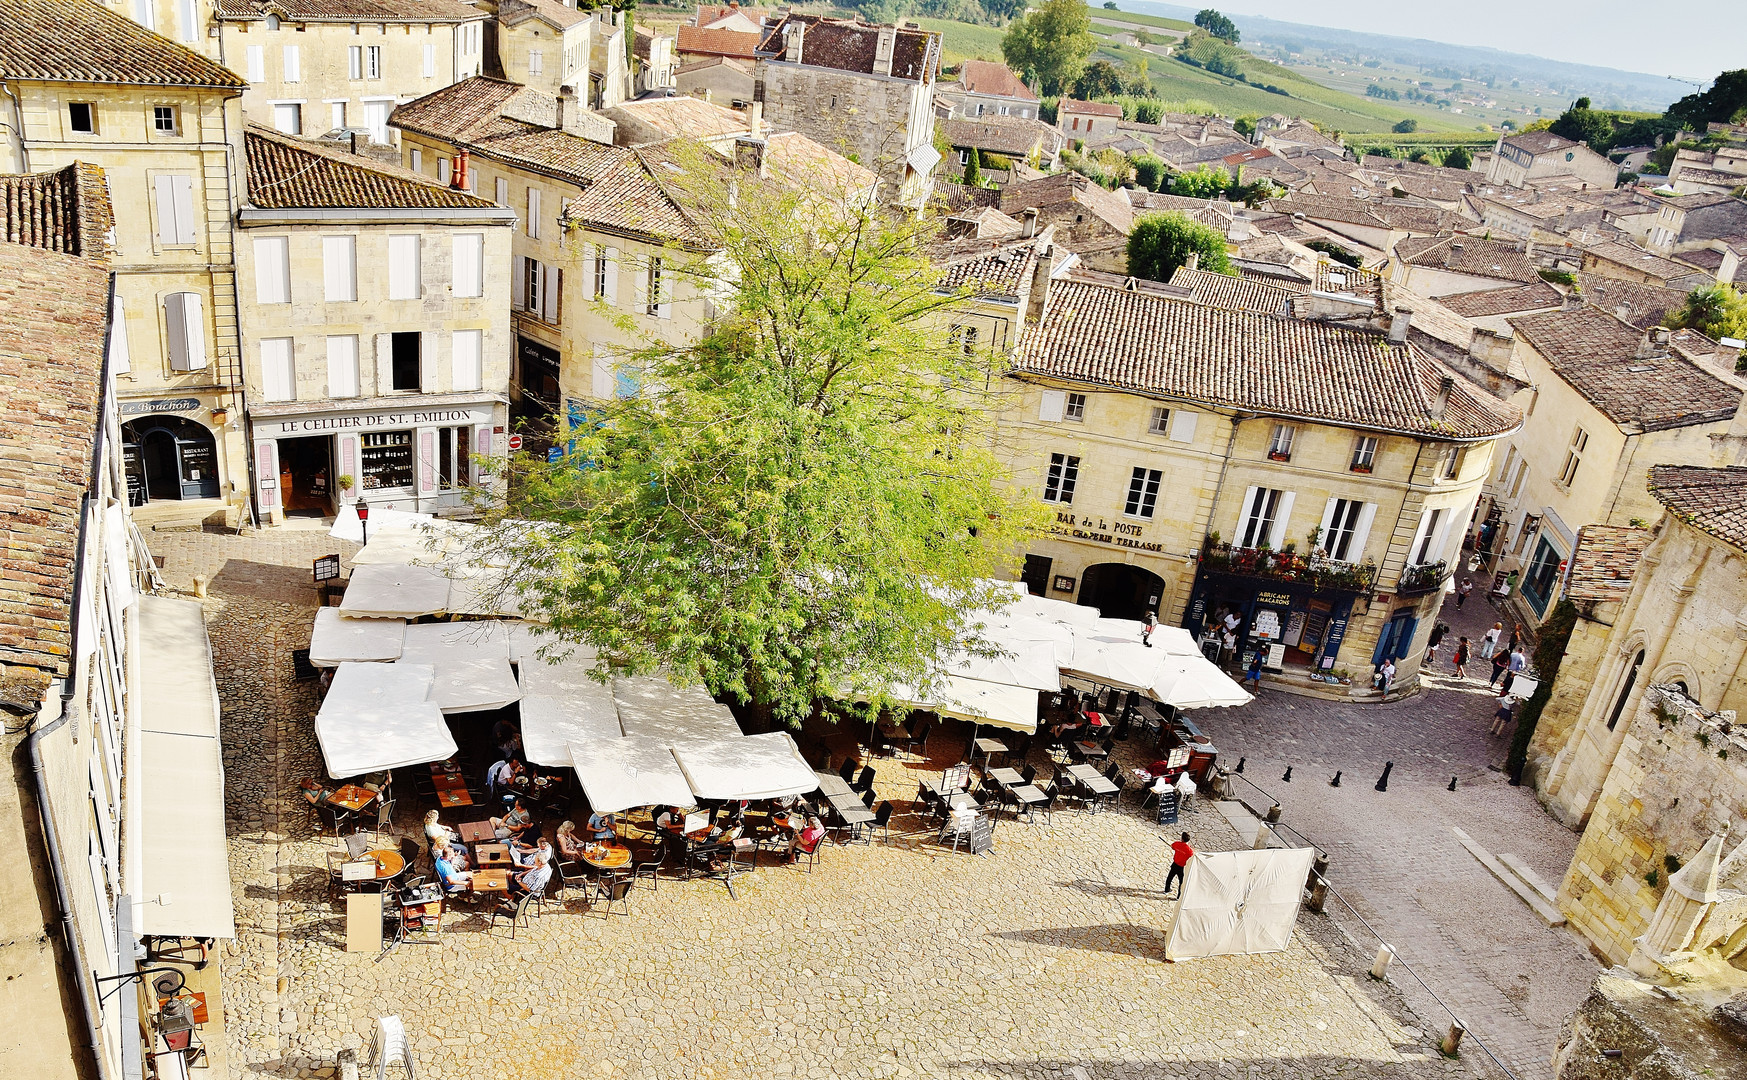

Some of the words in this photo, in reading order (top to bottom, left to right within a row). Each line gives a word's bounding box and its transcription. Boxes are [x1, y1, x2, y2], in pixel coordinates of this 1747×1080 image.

[121, 403, 135, 412] Le
[137, 400, 190, 412] Bouchon
[281, 421, 298, 432] LE
[303, 416, 361, 431] CELLIER
[366, 415, 384, 426] DE
[389, 414, 409, 424] ST.
[414, 410, 471, 423] EMILION
[1057, 512, 1076, 526] BAR
[1082, 517, 1093, 527] de
[1099, 519, 1107, 530] la
[1114, 522, 1143, 537] POSTE
[1116, 537, 1162, 551] TERRASSE
